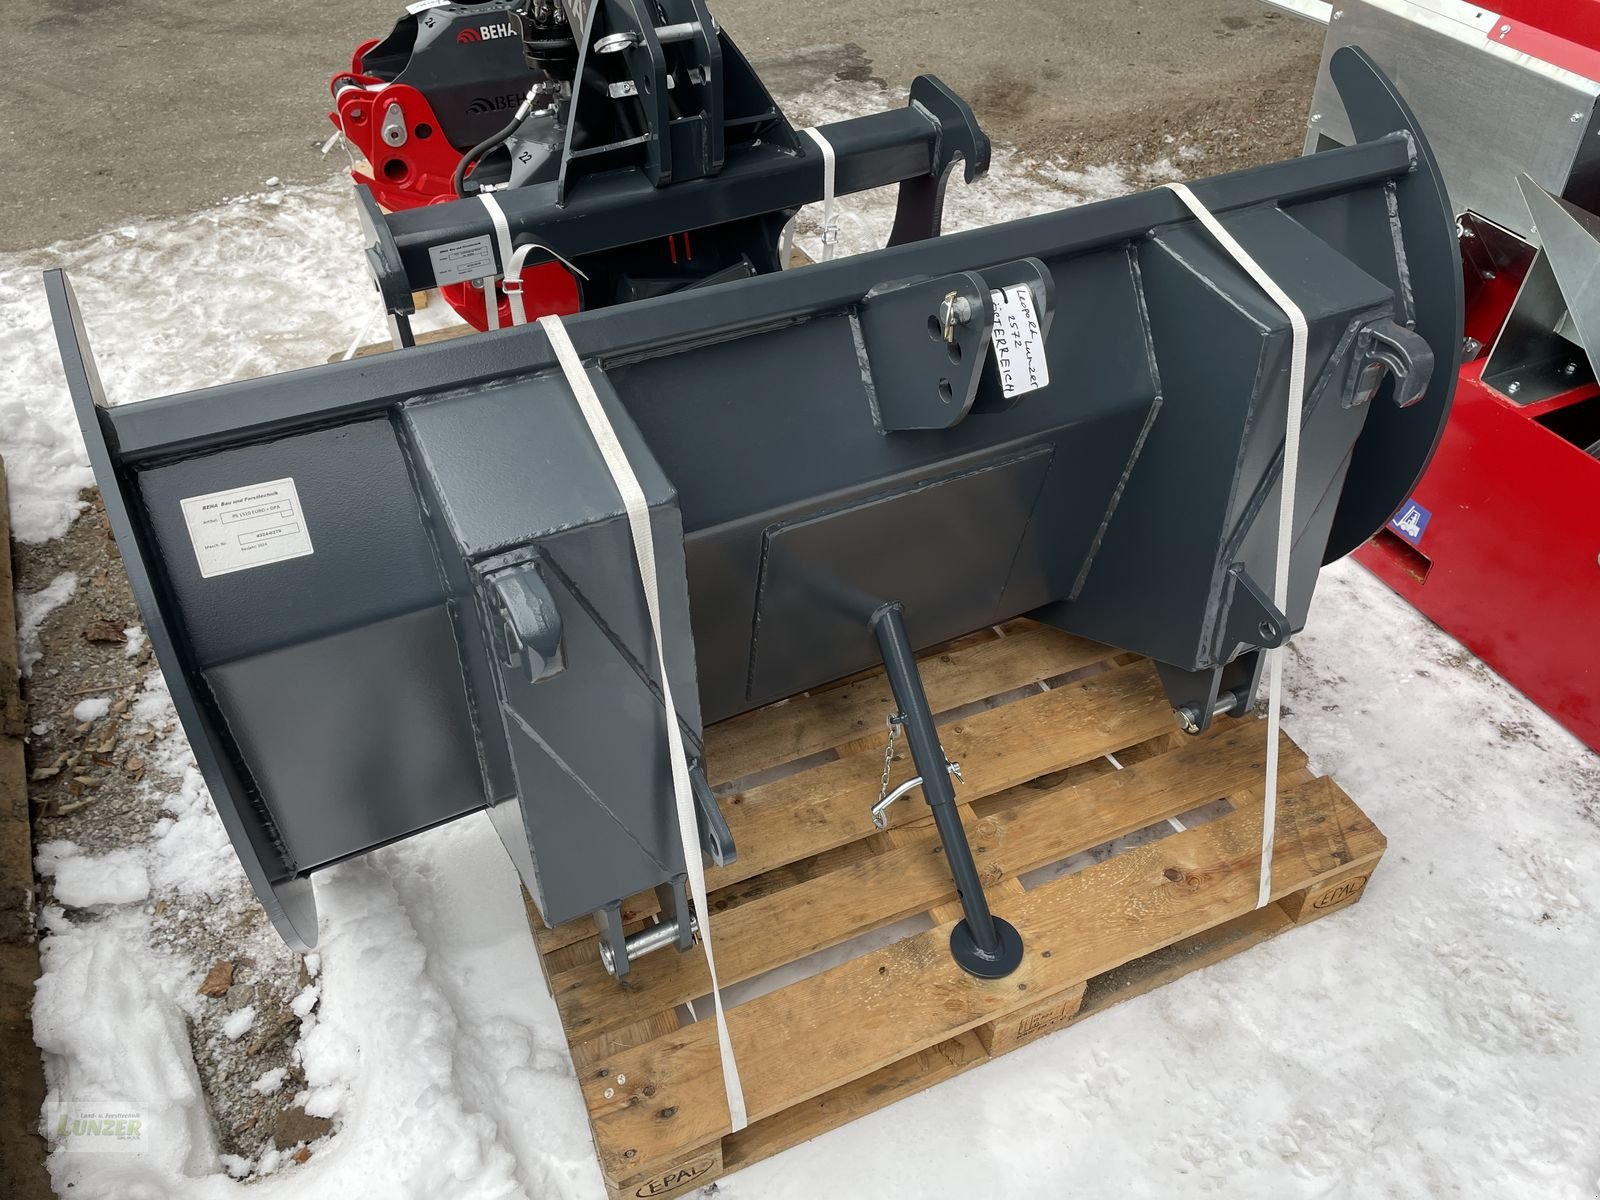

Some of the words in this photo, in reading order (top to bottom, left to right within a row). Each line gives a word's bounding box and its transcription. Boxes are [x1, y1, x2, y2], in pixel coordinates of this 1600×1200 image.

[518, 151, 532, 164] 22
[1008, 315, 1022, 348] 2572
[649, 1167, 705, 1194] EPAL
